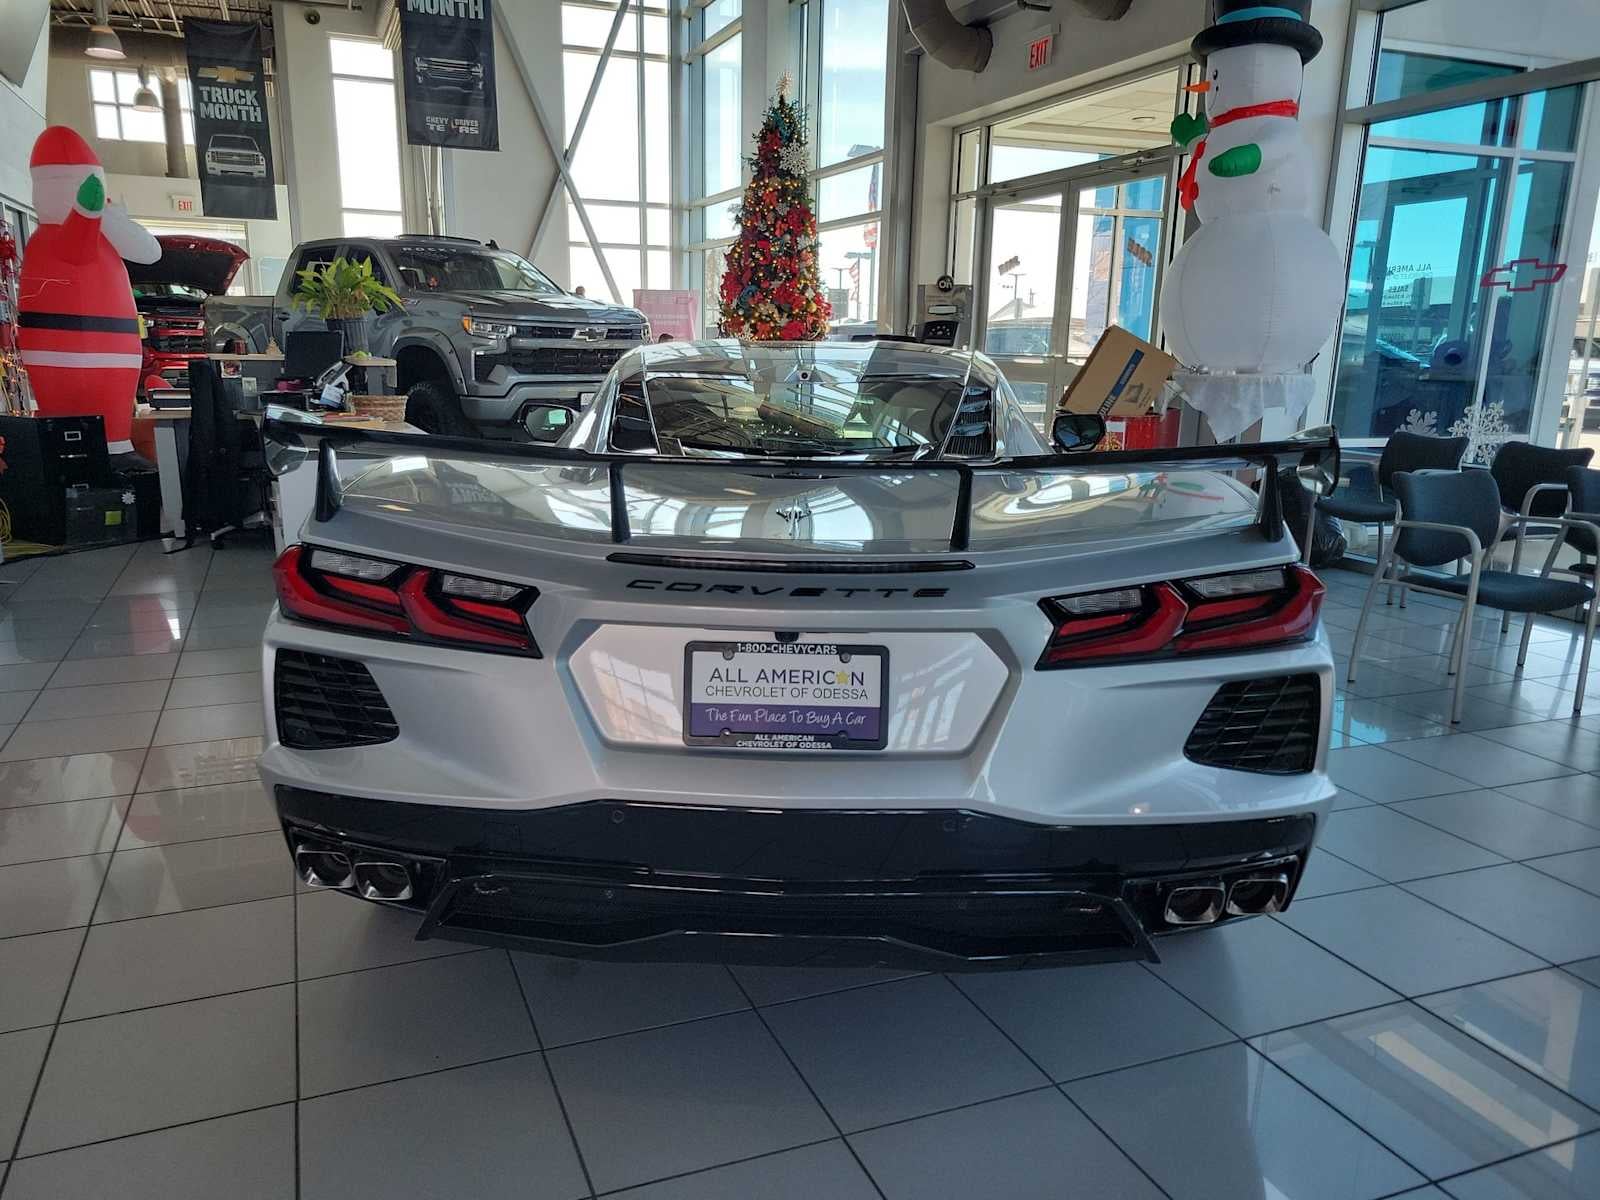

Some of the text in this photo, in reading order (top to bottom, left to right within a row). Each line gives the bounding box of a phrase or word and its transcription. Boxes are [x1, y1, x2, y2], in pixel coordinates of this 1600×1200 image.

[406, 0, 484, 19] MONTH
[1029, 38, 1049, 69] EXIT
[199, 86, 258, 106] TRUCK
[199, 103, 262, 122] MONTH
[425, 116, 449, 125] CHEVY
[178, 200, 192, 210] EXIT
[626, 579, 950, 598] CORVETTE
[737, 643, 838, 655] 1-800-CHEVYCARS
[709, 667, 749, 683] ALL
[705, 685, 868, 700] CHEVROLET OF ODESSA
[705, 707, 867, 728] The Fun Place To Buy A Car
[736, 740, 783, 748] CHEVROLET
[799, 741, 832, 749] ODESSA
[771, 734, 814, 742] AMERICAN
